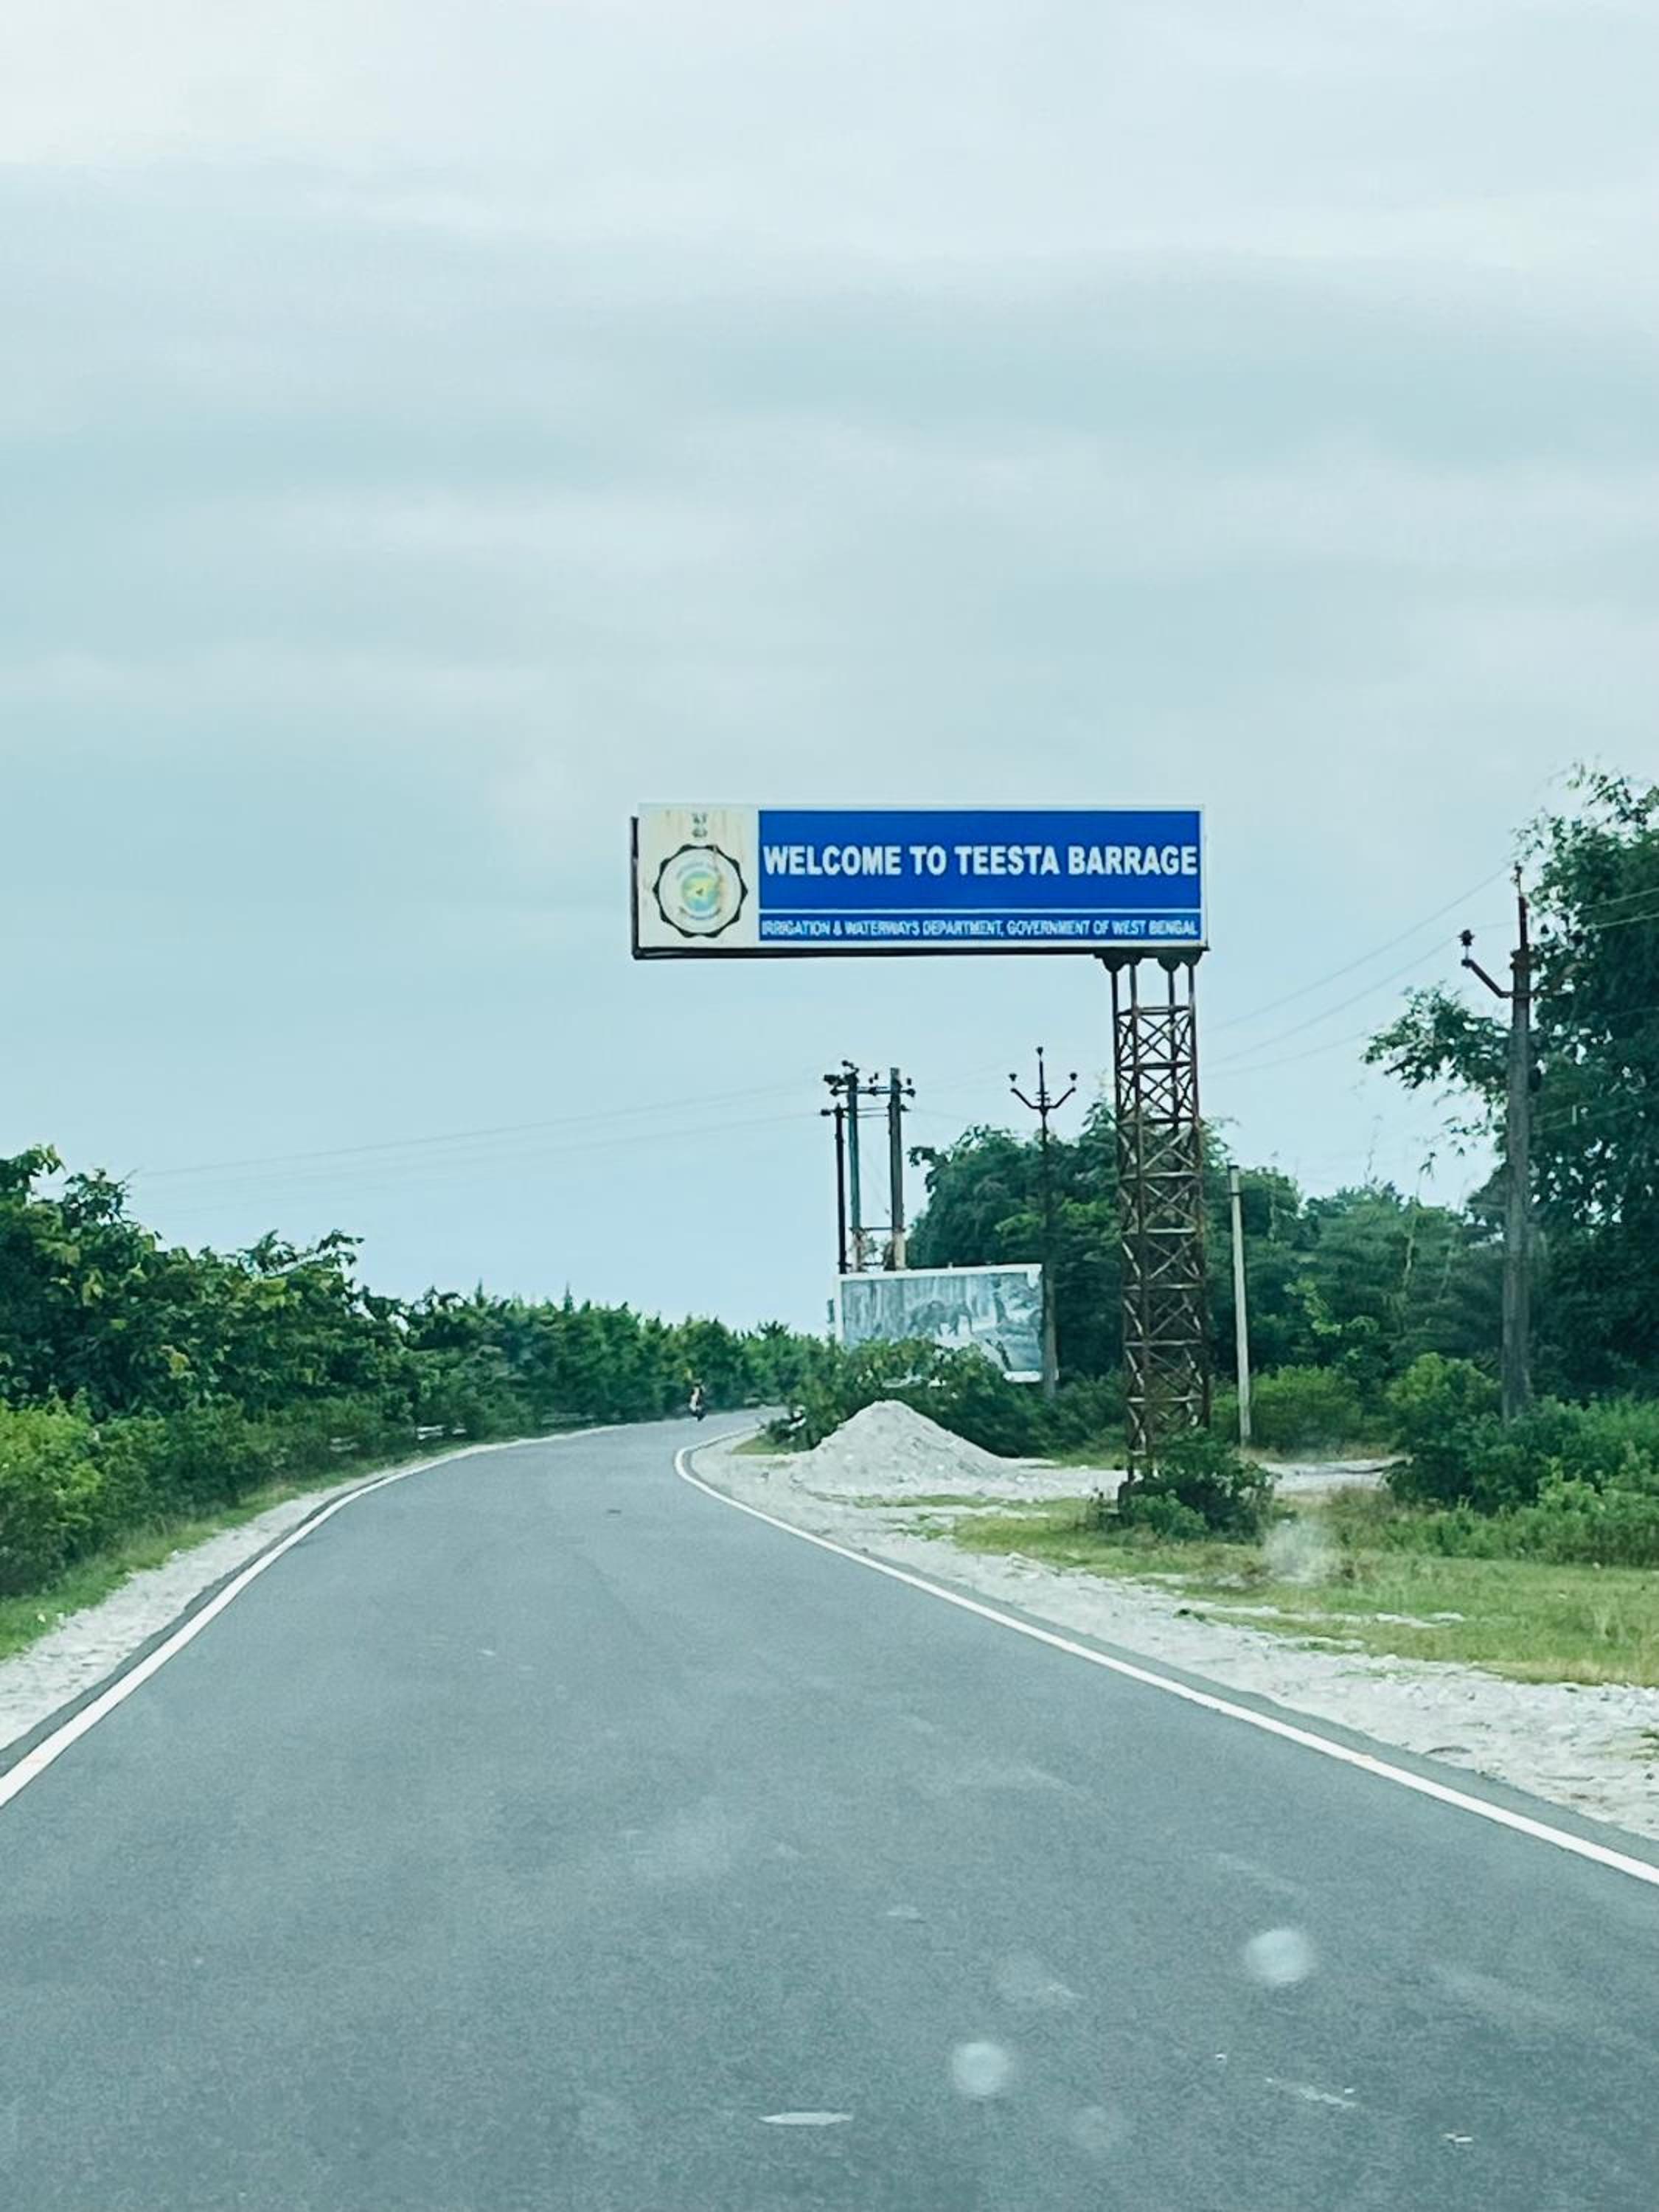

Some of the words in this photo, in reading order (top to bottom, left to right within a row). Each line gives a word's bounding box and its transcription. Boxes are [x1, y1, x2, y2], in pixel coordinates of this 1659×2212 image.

[763, 845, 901, 876] WELCOME
[909, 845, 947, 876] TO
[954, 845, 1060, 876] TEESTA
[1068, 845, 1197, 876] BARRAGE
[762, 920, 830, 936] IRRIGATION
[832, 920, 843, 936] &
[845, 920, 920, 936] WATERWAYS
[1006, 919, 1090, 936] GOVERNMENT
[1093, 919, 1109, 936] OF
[1112, 919, 1145, 936] WEST
[1148, 919, 1197, 936] BENGAL
